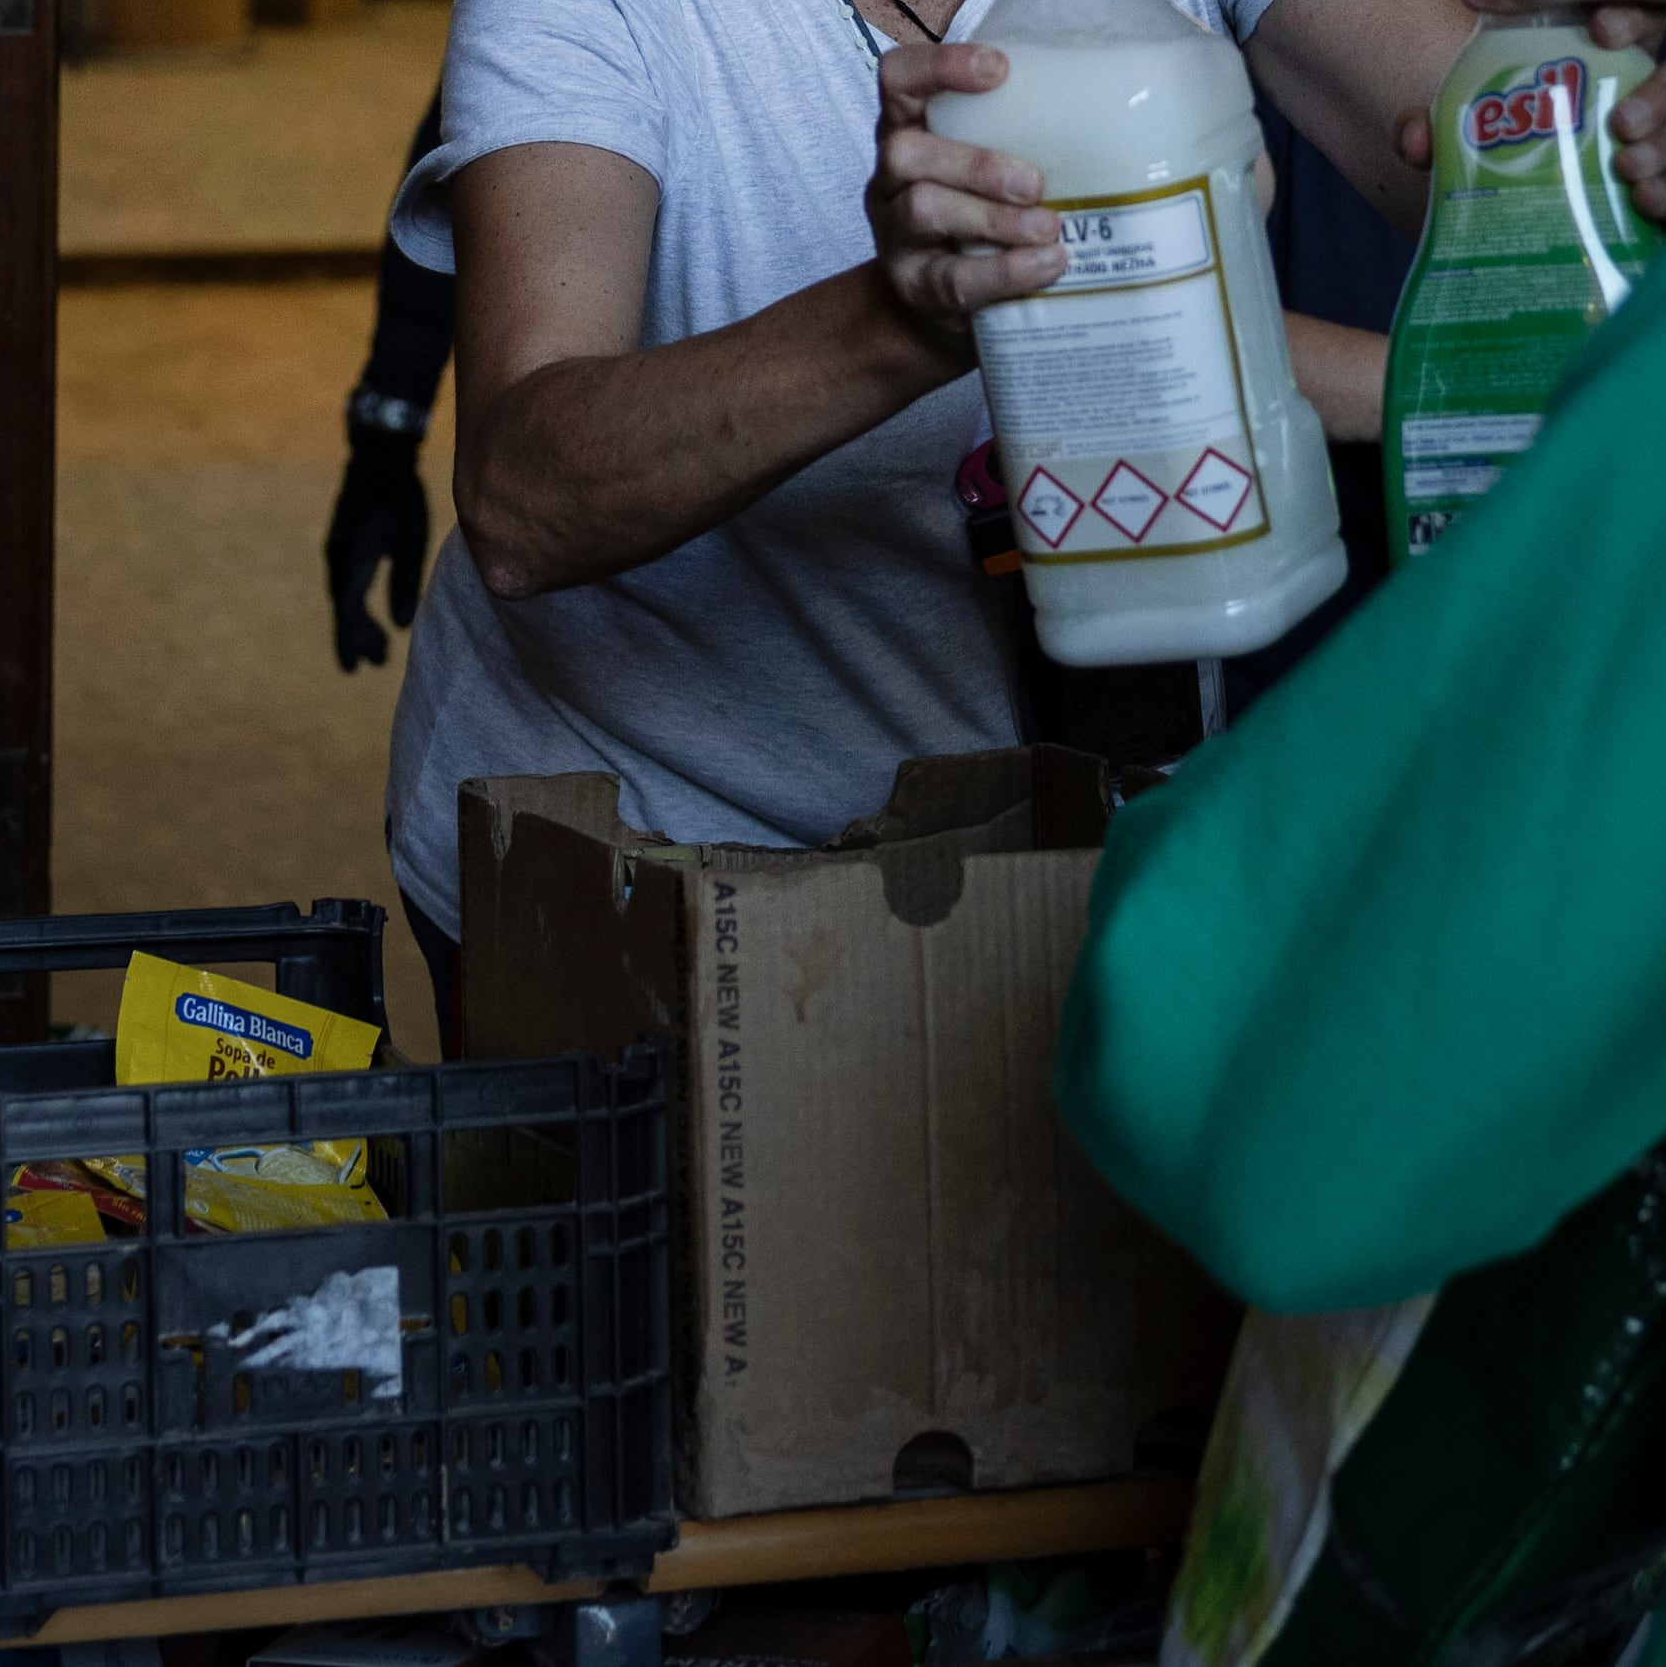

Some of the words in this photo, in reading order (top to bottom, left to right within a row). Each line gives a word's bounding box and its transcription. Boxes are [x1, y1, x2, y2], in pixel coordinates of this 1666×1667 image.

[1471, 60, 1583, 146] esil
[1057, 216, 1112, 243] LV-6
[714, 881, 739, 954] A15C
[182, 997, 246, 1034] Gallina
[249, 1014, 304, 1055] Blanca
[716, 963, 741, 1031] NEW
[216, 1037, 251, 1064] Sopa
[256, 1050, 275, 1070] de
[718, 1038, 743, 1113] A15C
[719, 1122, 744, 1189] NEW
[721, 1197, 746, 1272] A15C
[723, 1280, 748, 1348] NEW
